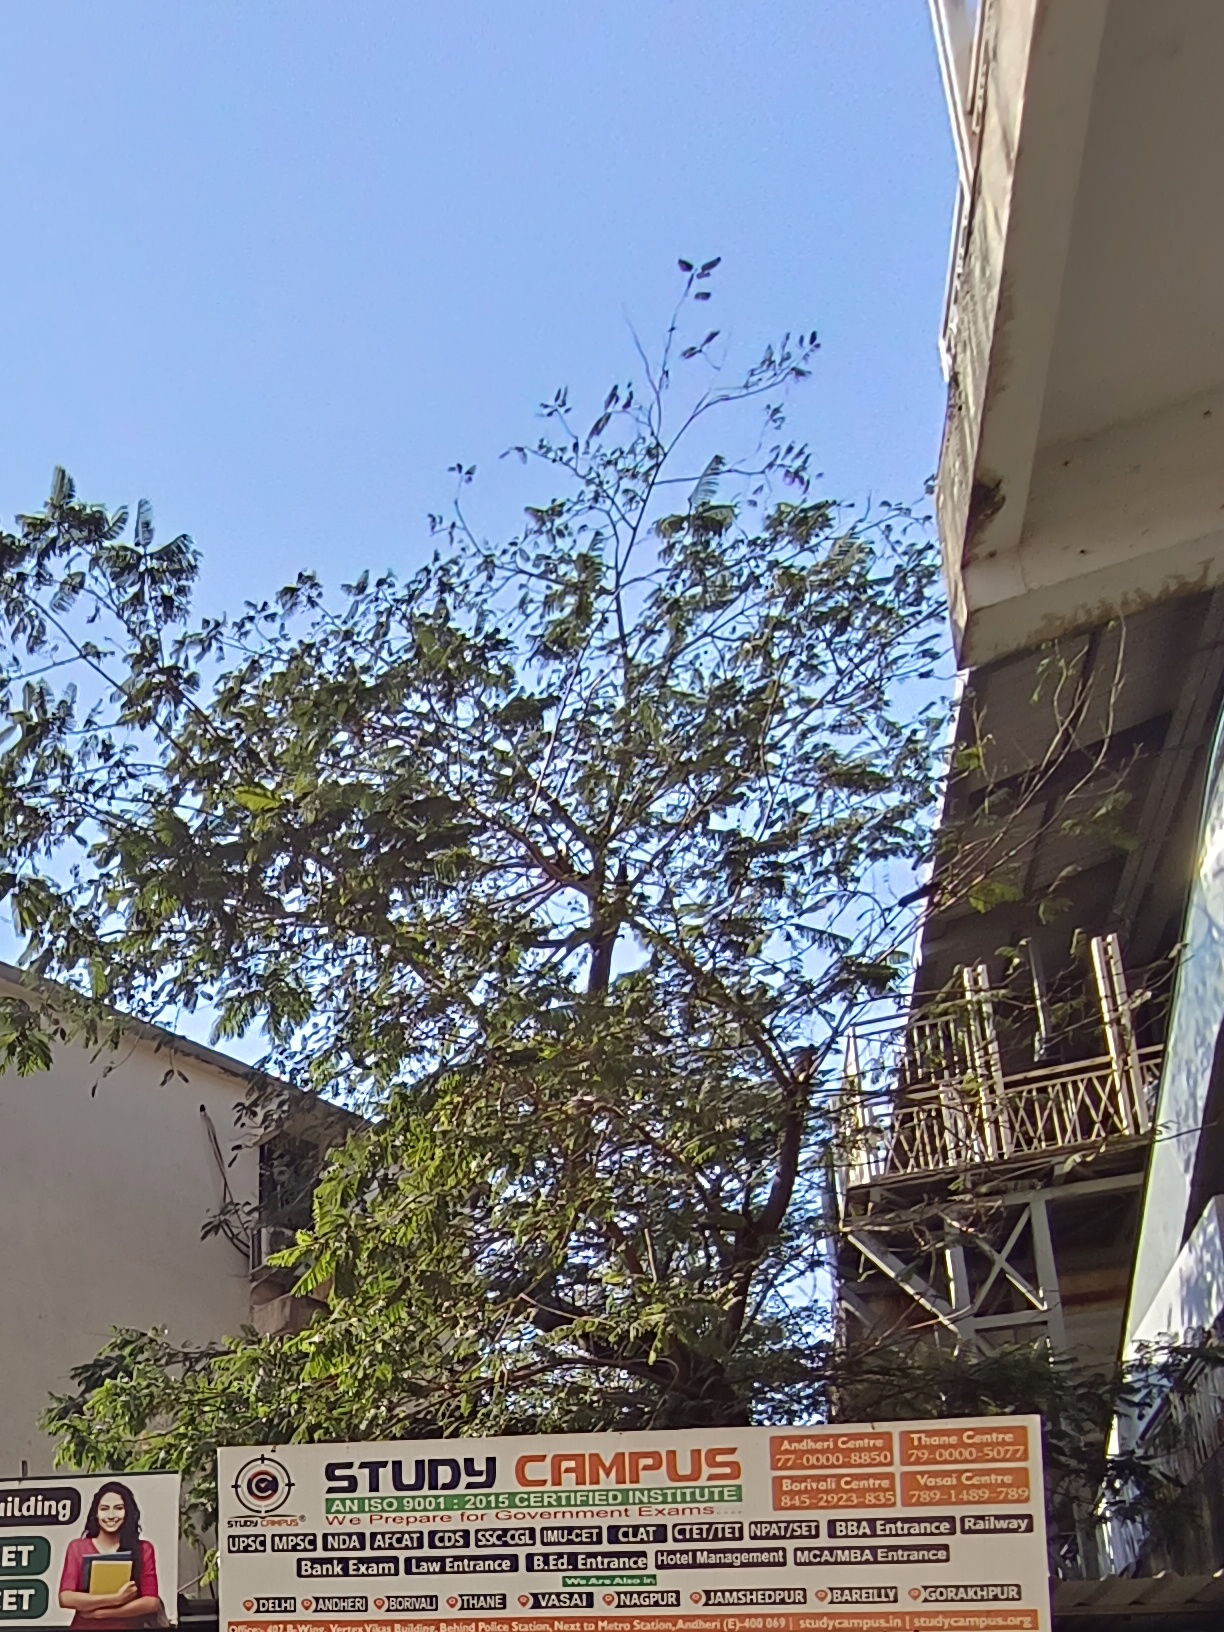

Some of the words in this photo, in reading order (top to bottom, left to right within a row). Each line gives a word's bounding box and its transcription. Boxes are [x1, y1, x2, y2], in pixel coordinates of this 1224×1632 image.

[324, 1456, 497, 1495] STUDY
[515, 1447, 742, 1488] CAMPUS
[330, 1500, 359, 1513] AN
[364, 1499, 398, 1512] ISO
[402, 1495, 447, 1512] 9001
[464, 1494, 509, 1510] 2015
[514, 1490, 622, 1508] CERTIFIED
[628, 1487, 737, 1504] INSTITUTE
[835, 1521, 872, 1536] BBA
[876, 1520, 951, 1535] Entrance
[964, 1516, 1028, 1532] Railway
[373, 1533, 420, 1548] AFCAT
[434, 1532, 464, 1547] CDS
[477, 1530, 534, 1545] SSC-CGL
[543, 1528, 599, 1543] IMU-CET
[618, 1526, 656, 1542] CLAT
[229, 1537, 265, 1551] UPSC
[274, 1535, 314, 1550] MPSC
[327, 1535, 360, 1549] NDA
[300, 1560, 343, 1576] Bank
[348, 1559, 395, 1575] Exam
[411, 1558, 441, 1573] Law
[445, 1558, 511, 1572] Entrance
[538, 1593, 587, 1607] VASAI
[925, 1586, 1019, 1601] GORAKHPUR
[259, 1599, 295, 1612] DELHI
[317, 1598, 366, 1611] ANDHERI
[462, 1595, 504, 1608] THANE
